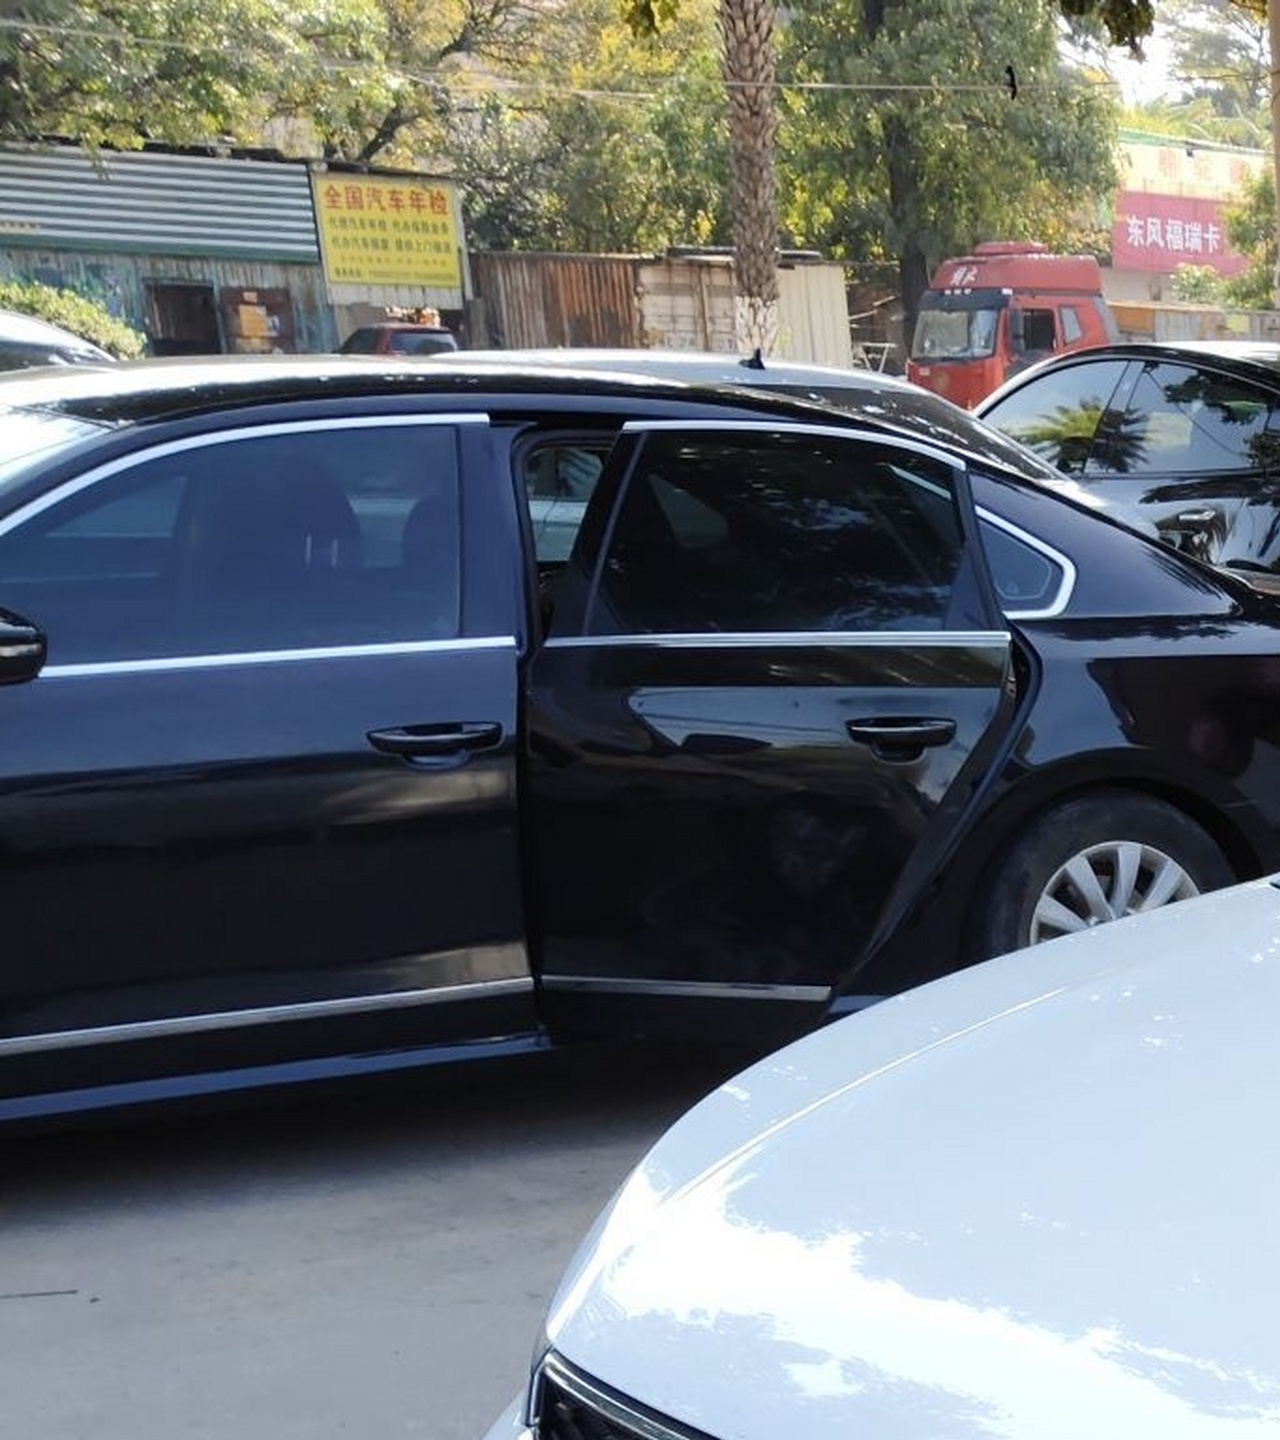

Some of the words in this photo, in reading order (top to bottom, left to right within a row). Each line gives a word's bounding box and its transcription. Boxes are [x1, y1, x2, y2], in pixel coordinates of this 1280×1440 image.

[324, 184, 449, 215] 全国汽车年检
[1126, 214, 1221, 253] 东风福瑞卡
